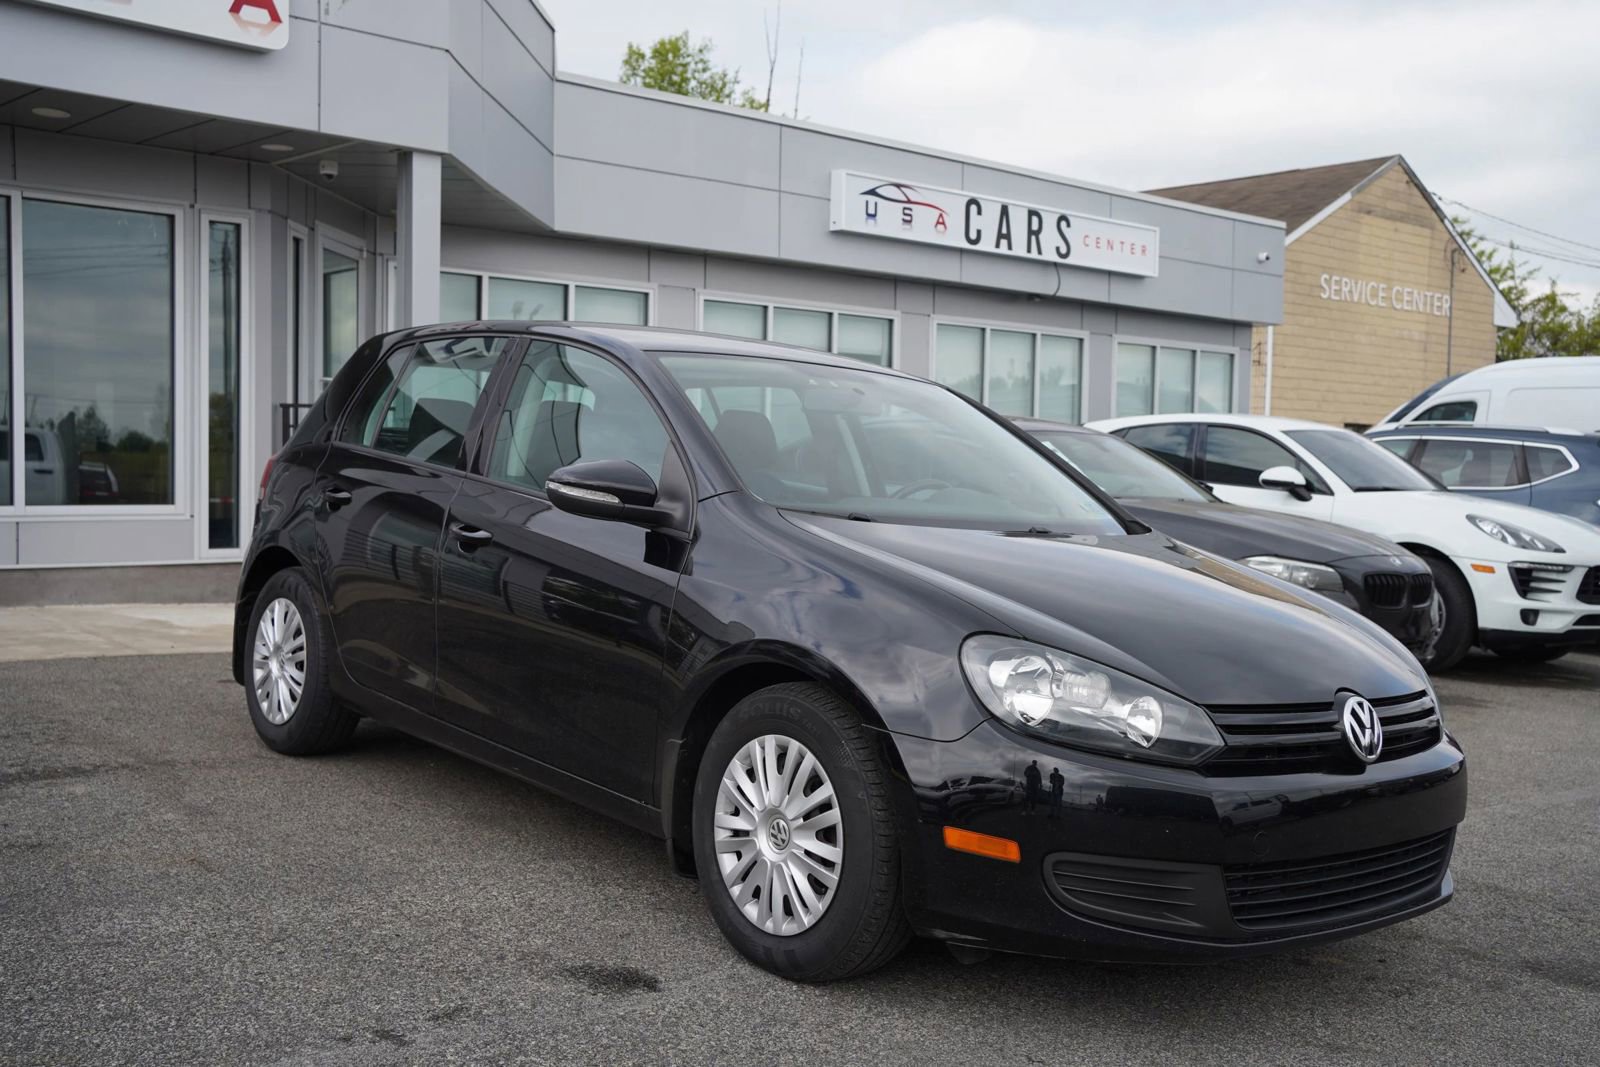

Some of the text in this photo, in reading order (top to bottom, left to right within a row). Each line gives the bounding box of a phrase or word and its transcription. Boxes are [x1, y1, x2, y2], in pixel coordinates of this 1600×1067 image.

[964, 198, 1071, 260] CARS
[1083, 235, 1147, 257] CENTER
[1320, 273, 1451, 317] SERVICE CENTER
